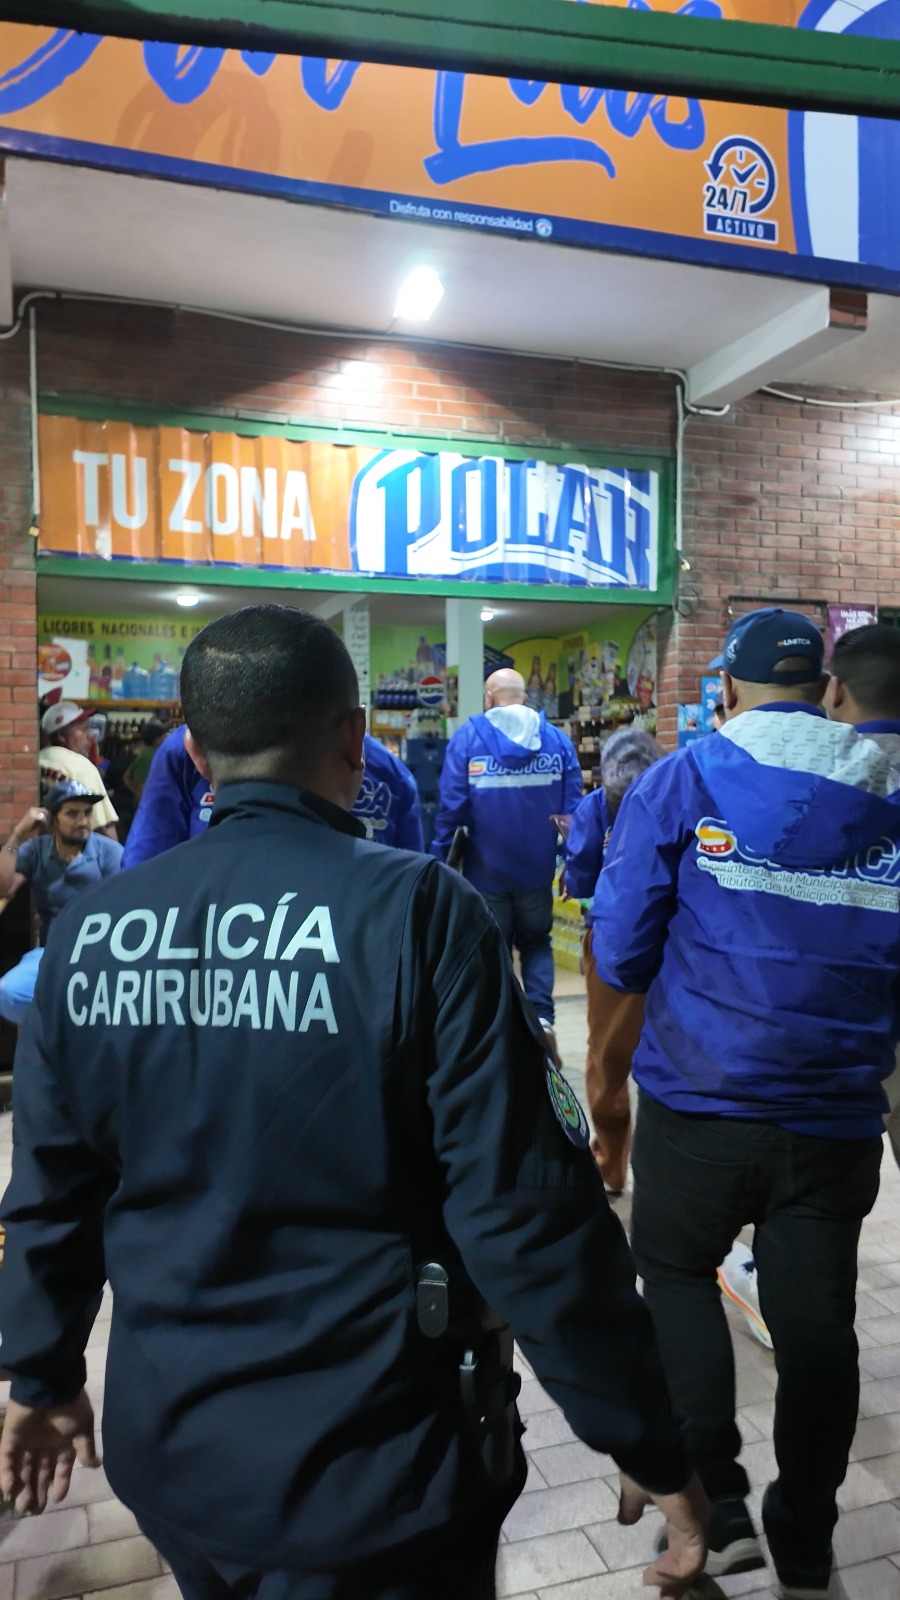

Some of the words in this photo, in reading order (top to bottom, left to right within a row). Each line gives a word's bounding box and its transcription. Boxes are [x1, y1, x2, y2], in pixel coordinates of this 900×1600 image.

[705, 184, 748, 214] 24/7
[389, 200, 431, 217] Disfruta
[432, 208, 452, 221] con
[454, 212, 533, 232] responsabilidad
[715, 217, 765, 238] ACTIVO
[72, 449, 148, 531] TU
[168, 458, 317, 542] ZONA
[376, 451, 650, 590] POLAR
[43, 620, 95, 635] LICORES
[101, 623, 177, 638] NACIONALES
[717, 872, 763, 888] Tributos
[783, 884, 839, 903] Municipio
[794, 872, 851, 890] Municipal
[69, 892, 341, 964] POLICÍA
[67, 968, 338, 1034] CARIRUBANA
